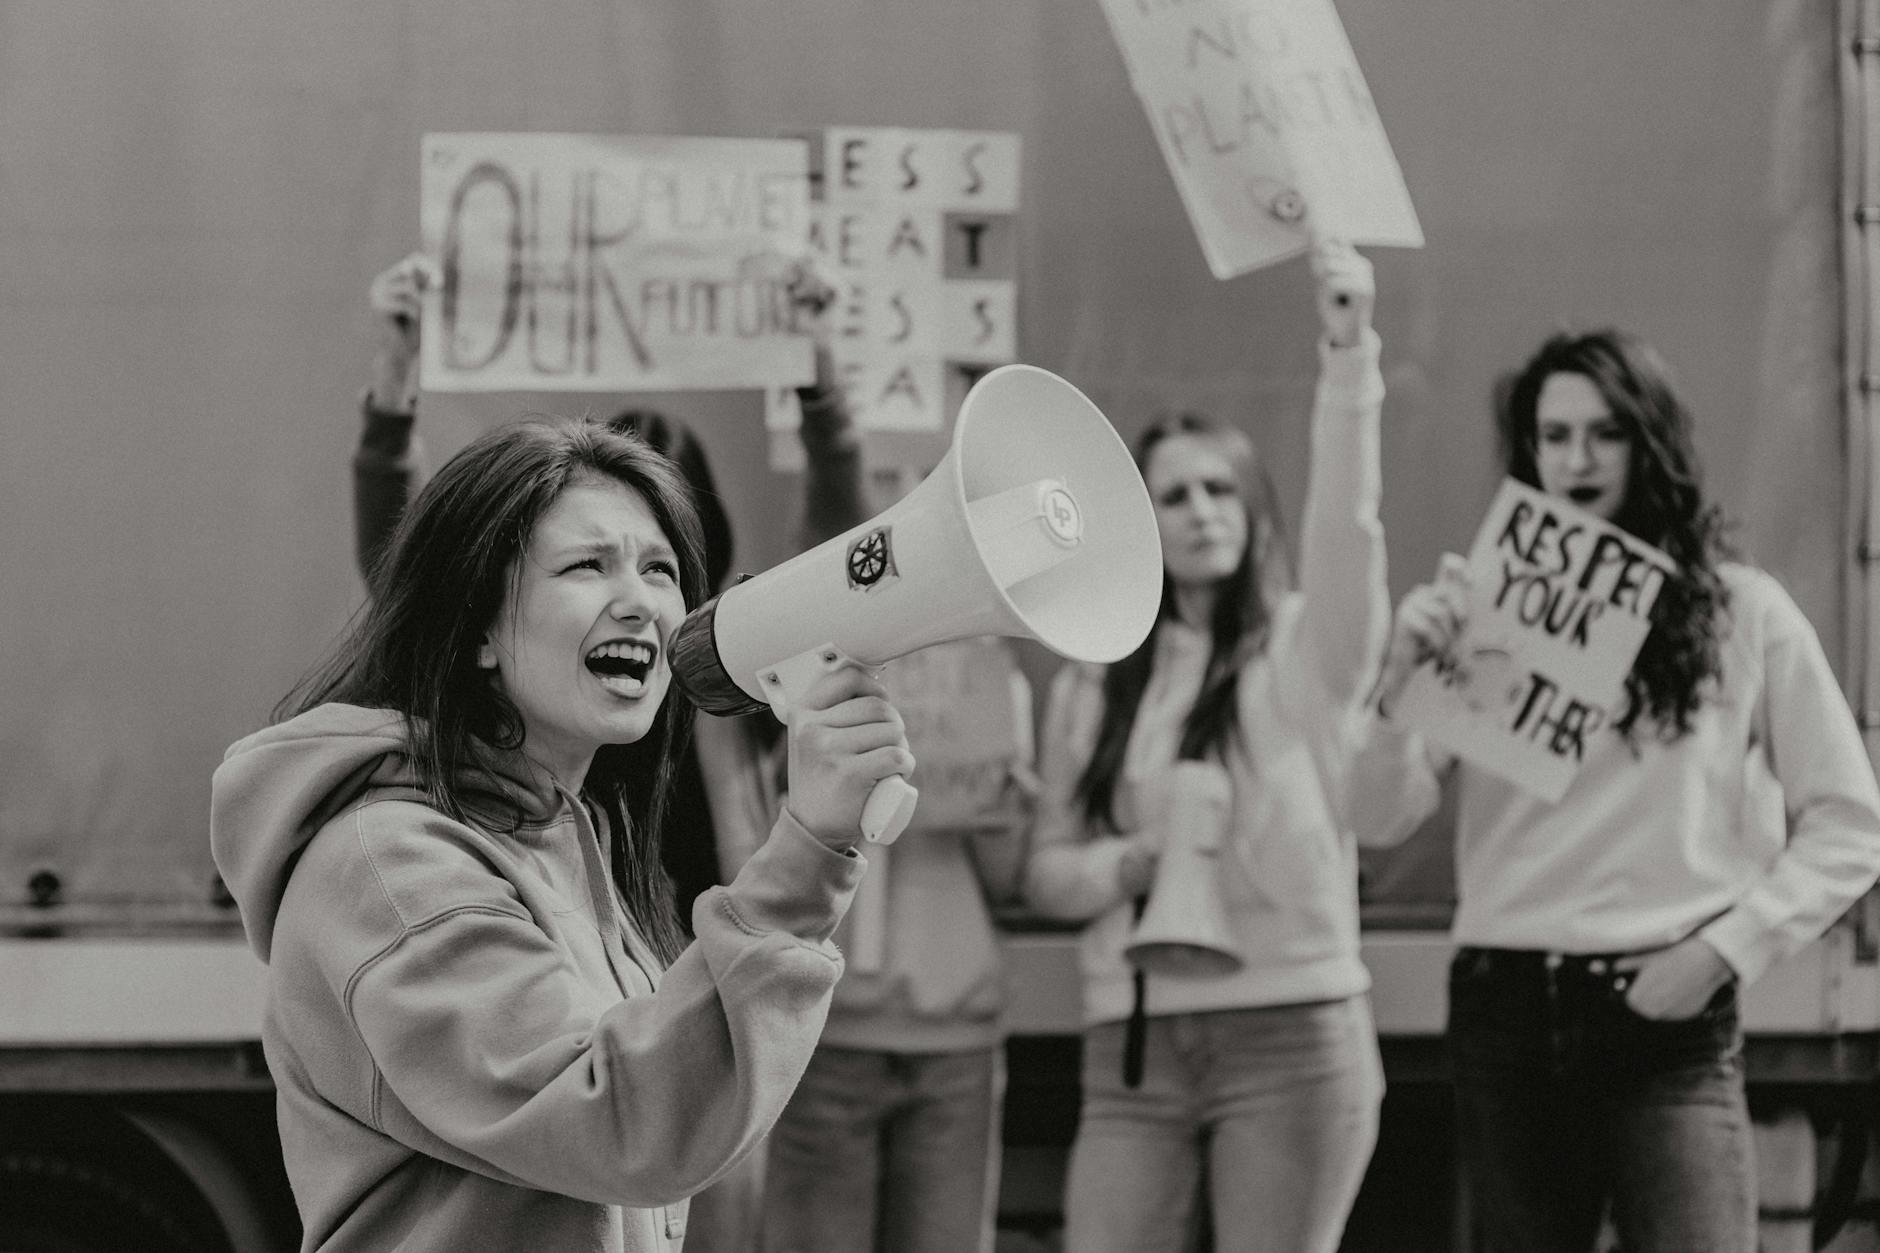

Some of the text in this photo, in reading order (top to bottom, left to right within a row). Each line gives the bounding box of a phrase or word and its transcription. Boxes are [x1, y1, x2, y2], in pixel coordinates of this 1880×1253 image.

[840, 138, 988, 195] ESS
[441, 161, 655, 376] OUR
[843, 285, 996, 345] ESS
[1496, 560, 1605, 648] YOUR
